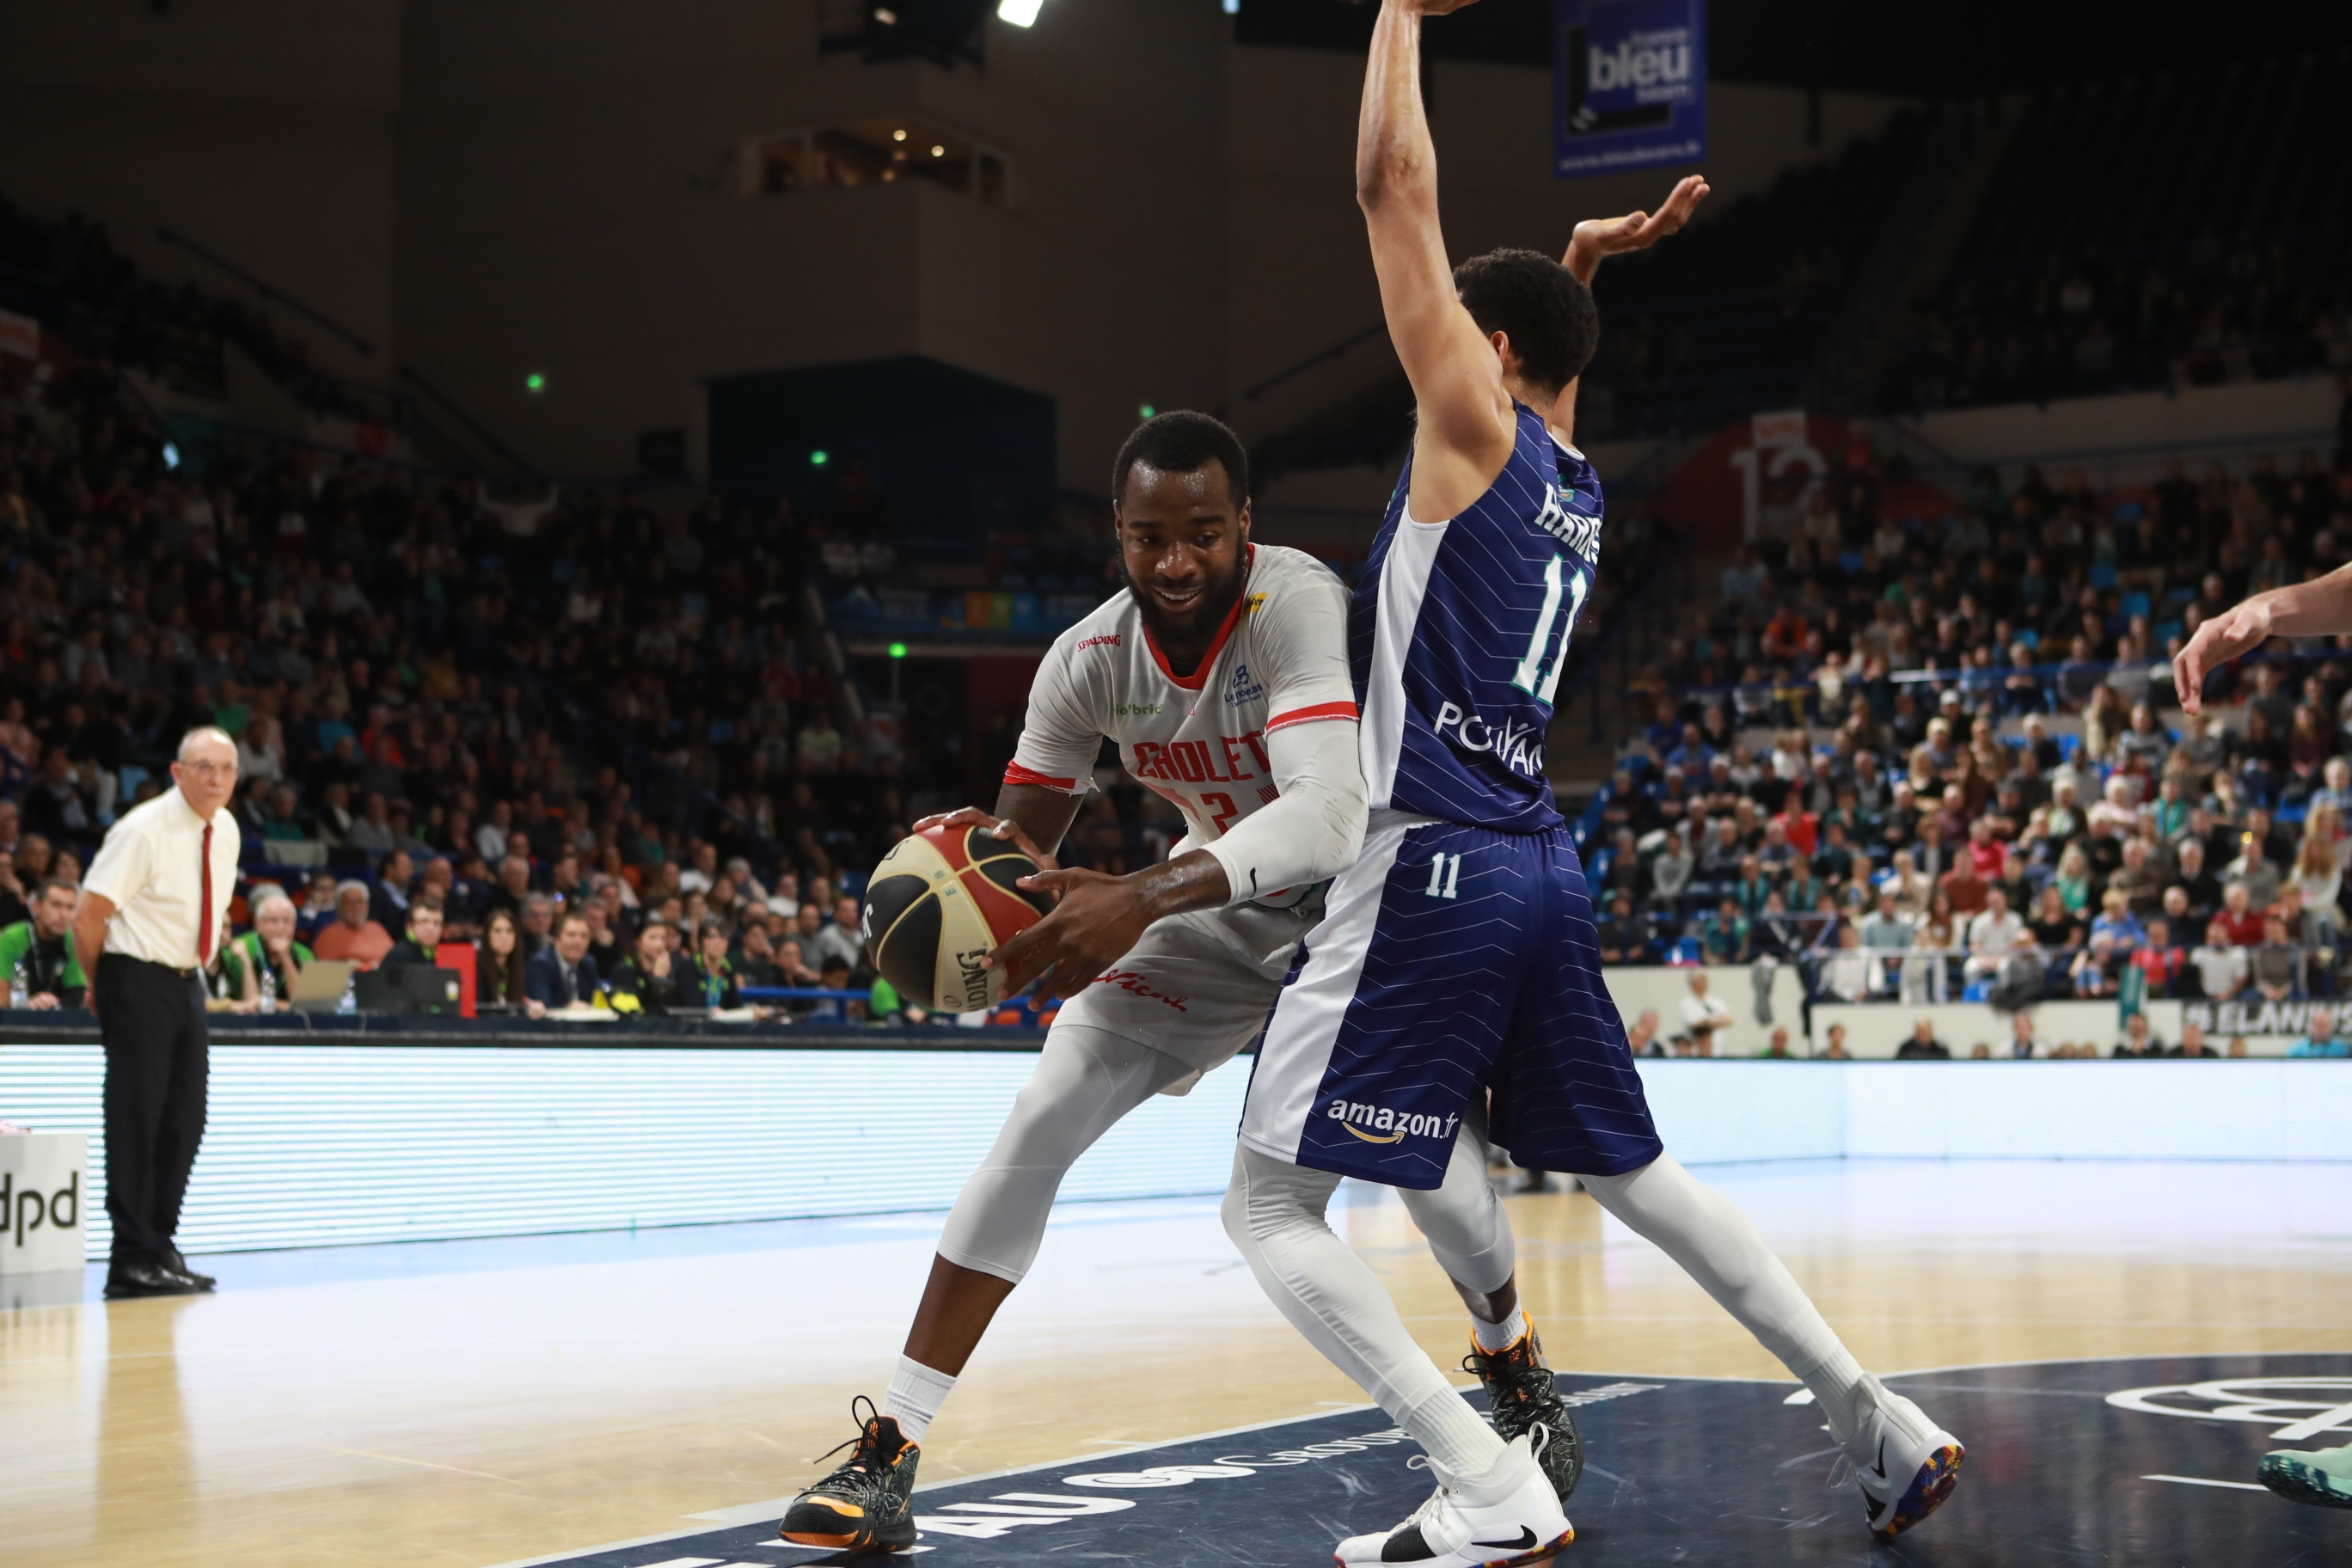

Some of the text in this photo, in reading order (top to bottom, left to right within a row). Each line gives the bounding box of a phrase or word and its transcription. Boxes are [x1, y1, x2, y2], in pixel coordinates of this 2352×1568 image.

[1589, 44, 1690, 91] bleu
[1077, 634, 1121, 652] SPALDING
[1510, 552, 1589, 707] 11
[1115, 704, 1162, 715] io'bric
[1133, 730, 1271, 783] CHOLET
[1425, 851, 1461, 900] 11
[1327, 1099, 1459, 1140] amazon.fr
